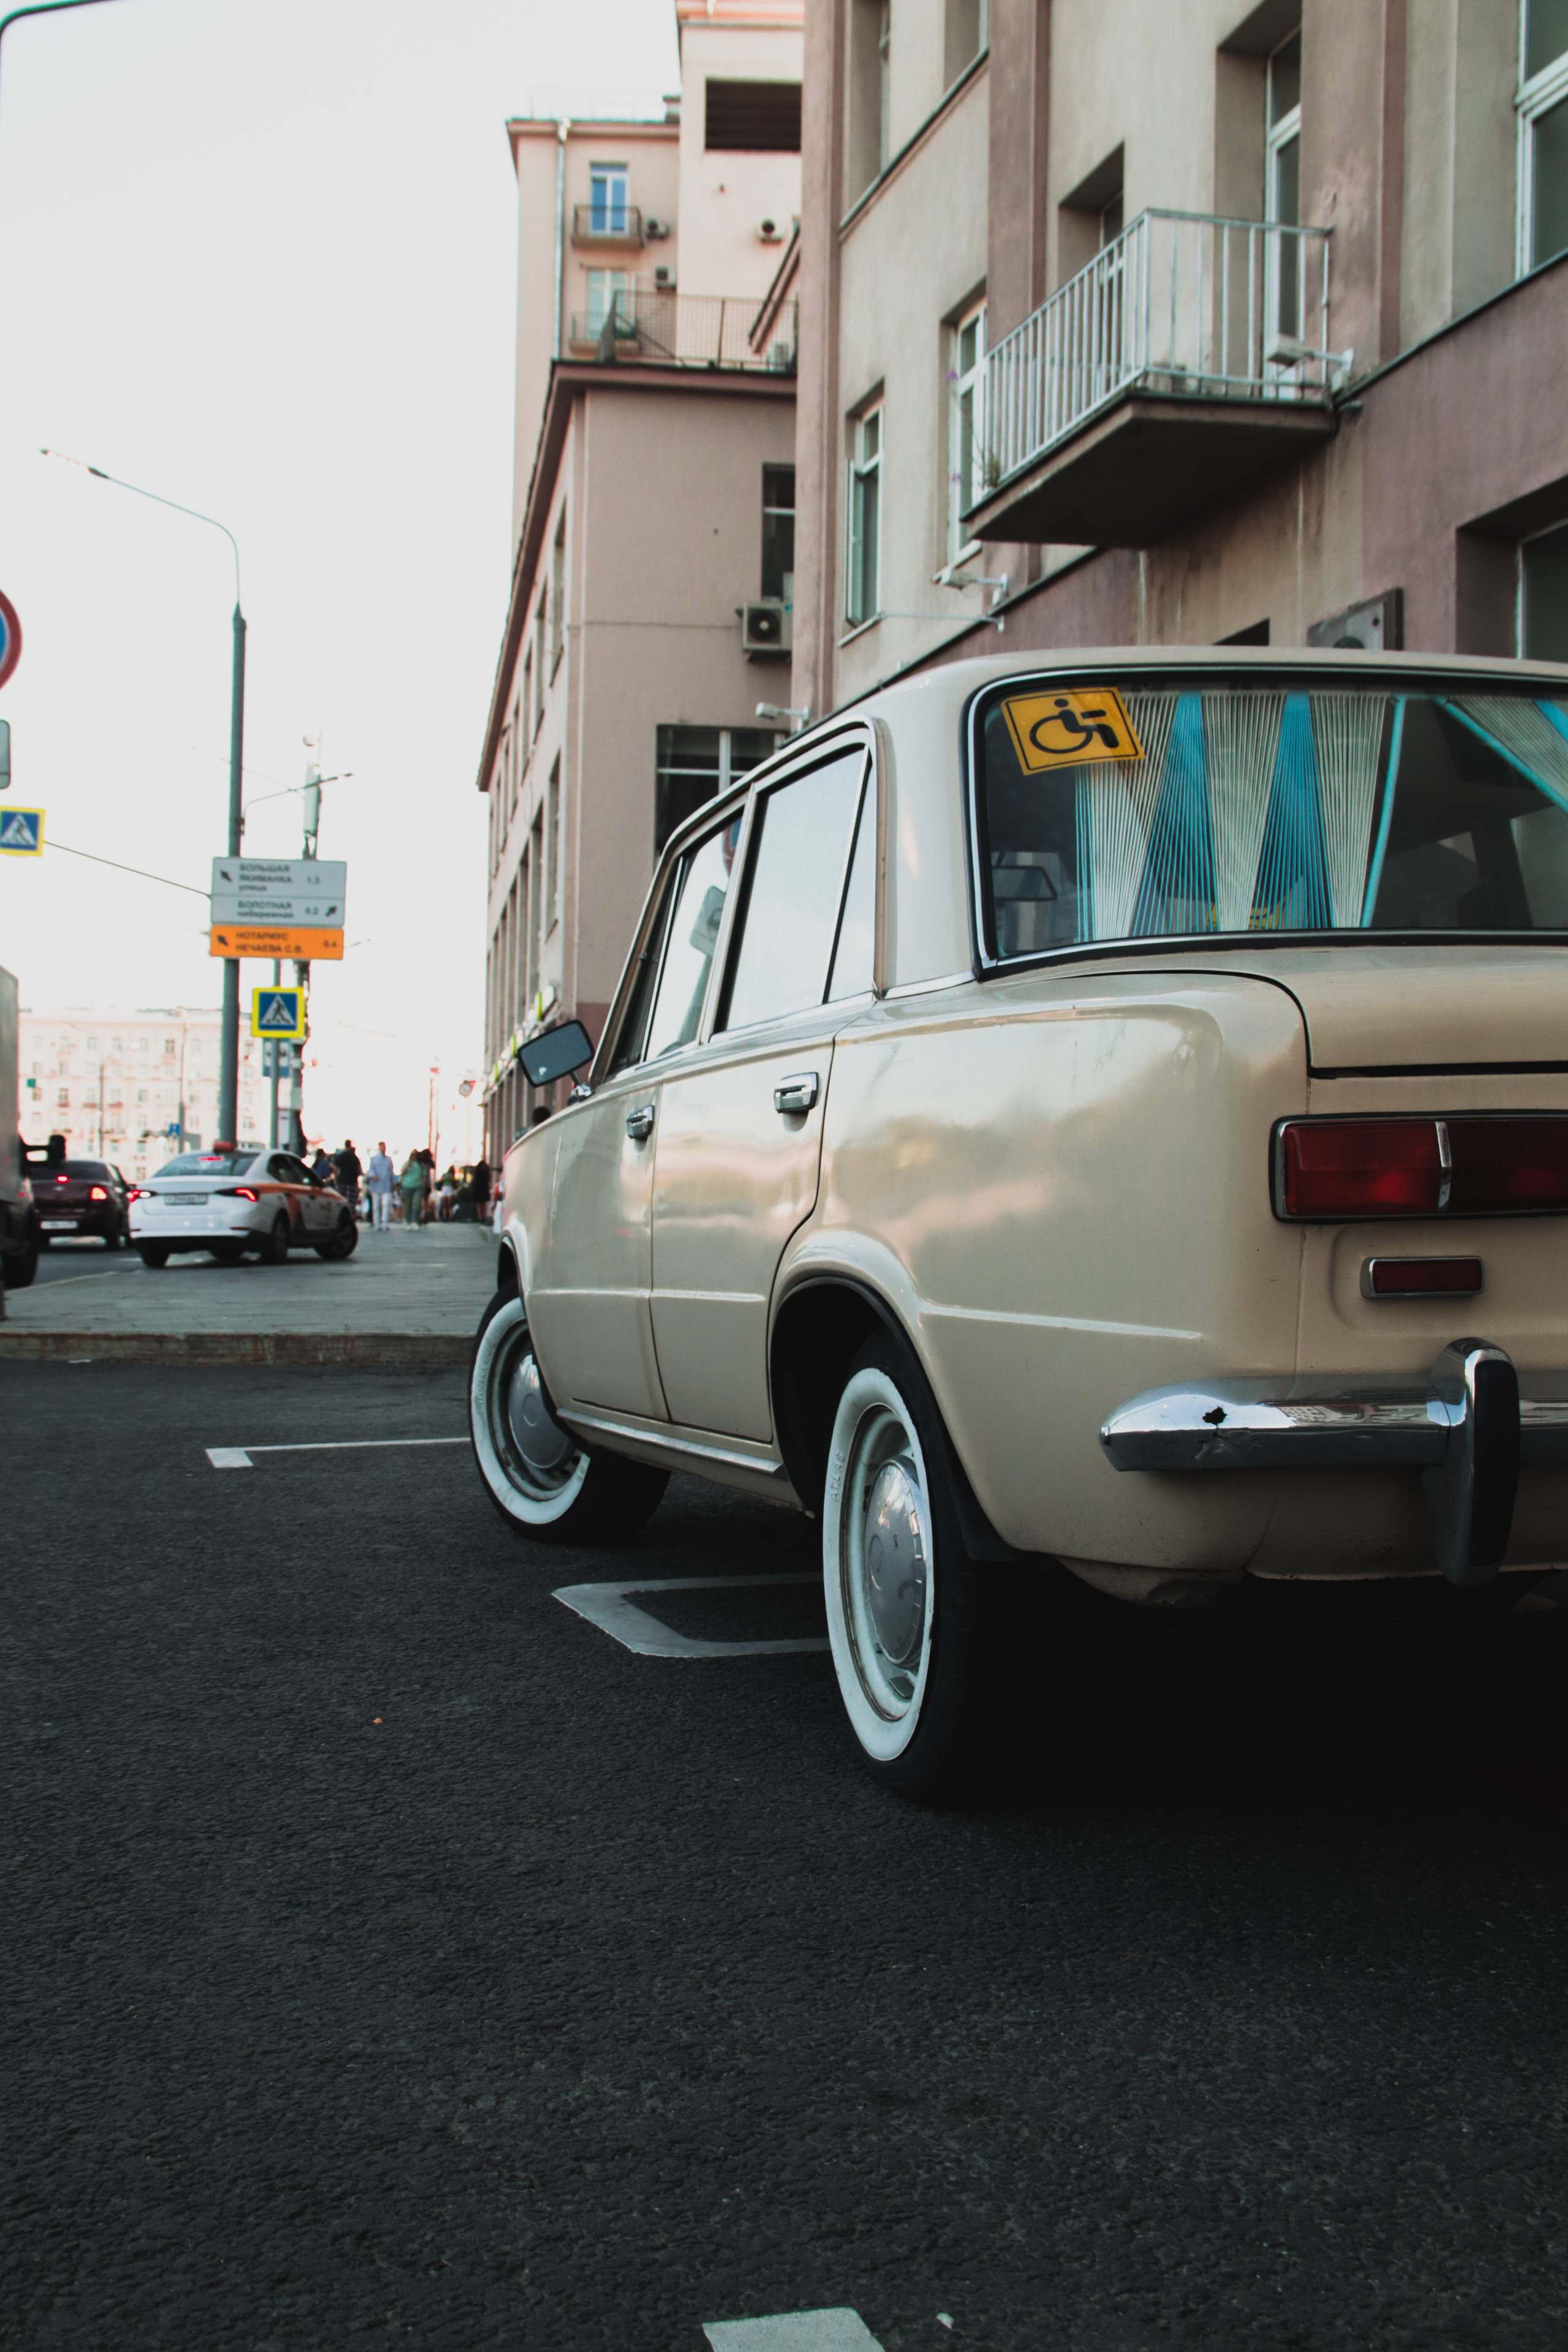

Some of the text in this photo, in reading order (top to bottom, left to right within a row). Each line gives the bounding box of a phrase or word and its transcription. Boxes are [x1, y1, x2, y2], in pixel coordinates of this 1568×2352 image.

[239, 863, 290, 872] БОЛЬШАЯ
[236, 931, 288, 940] НОТАРИУС
[830, 1452, 845, 1501] ATLAS
